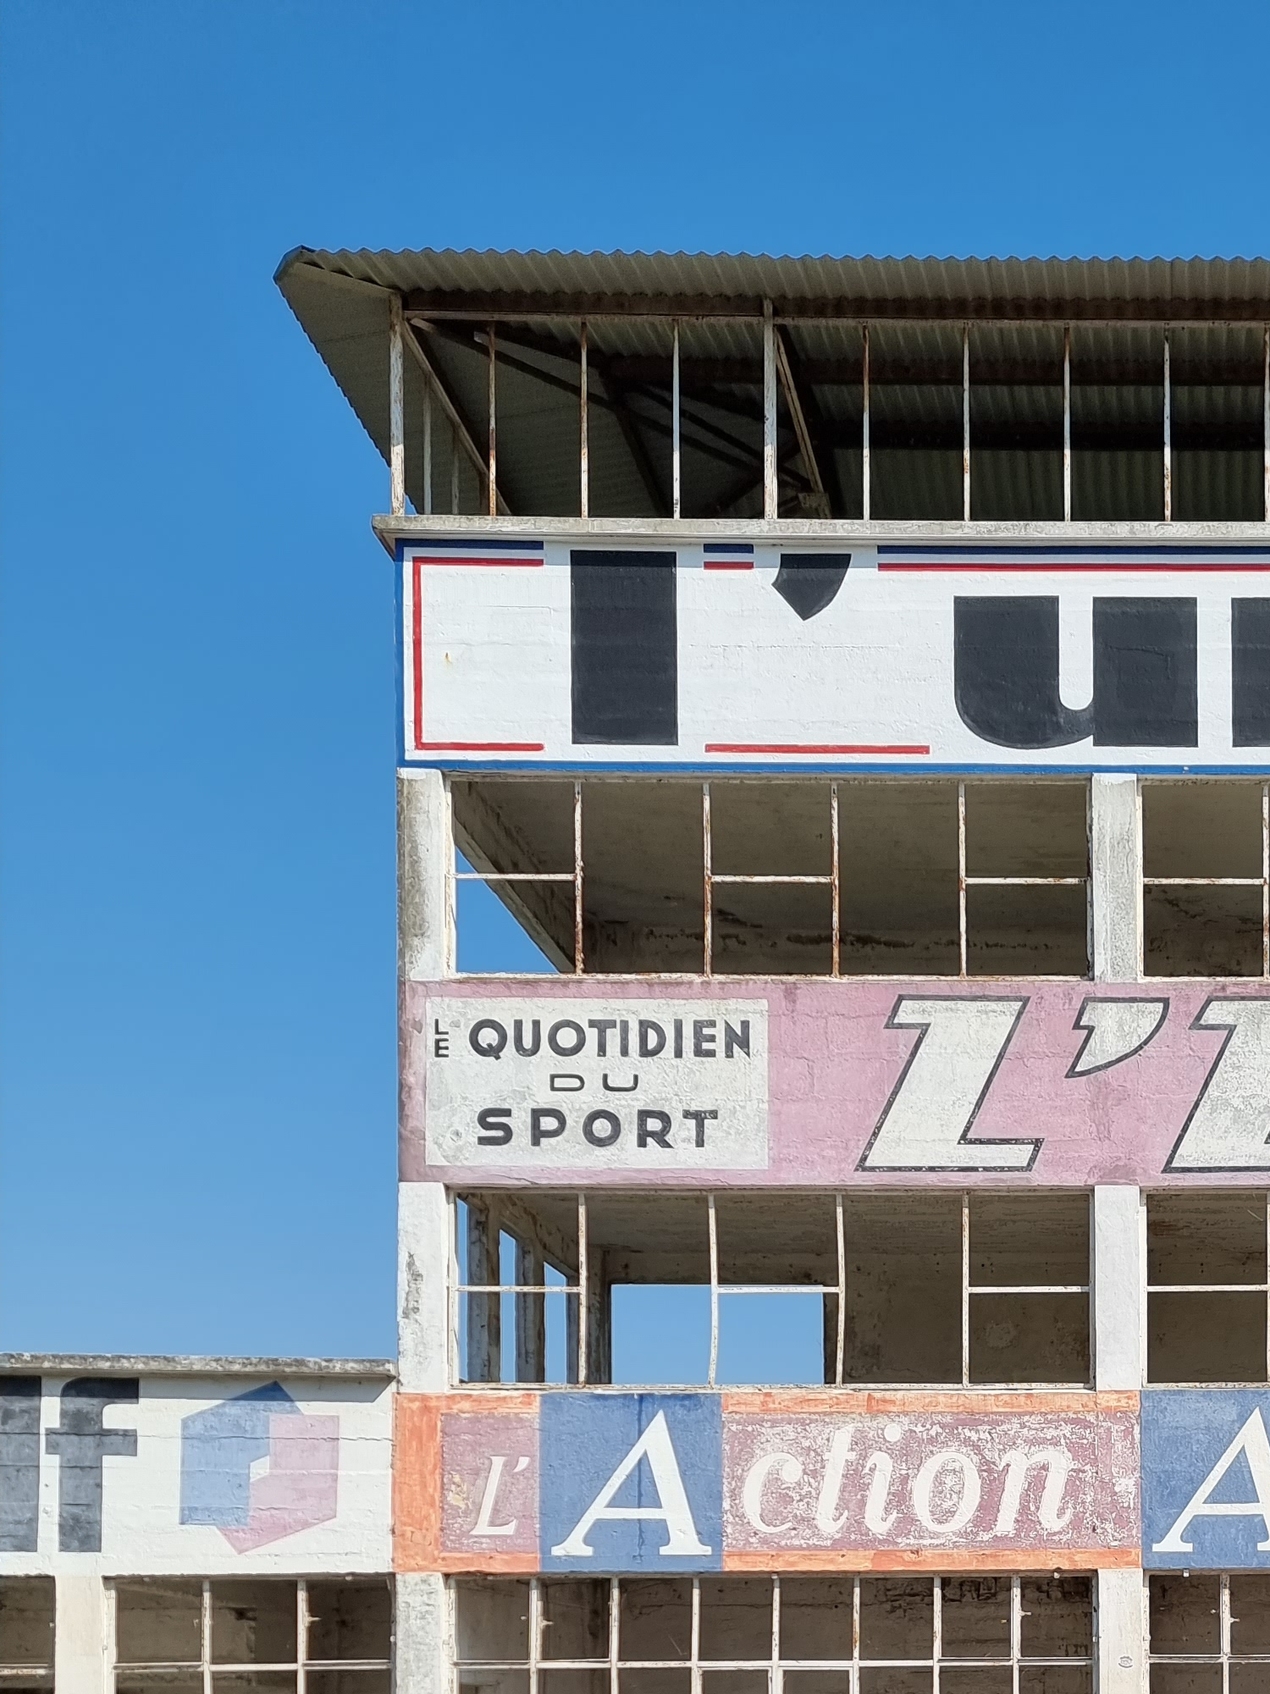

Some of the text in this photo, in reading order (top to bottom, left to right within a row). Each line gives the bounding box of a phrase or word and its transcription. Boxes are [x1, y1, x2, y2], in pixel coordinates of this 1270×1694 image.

[468, 1018, 751, 1061] QUOTIDIEN
[549, 1073, 639, 1092] DU
[476, 1107, 719, 1149] SPORT
